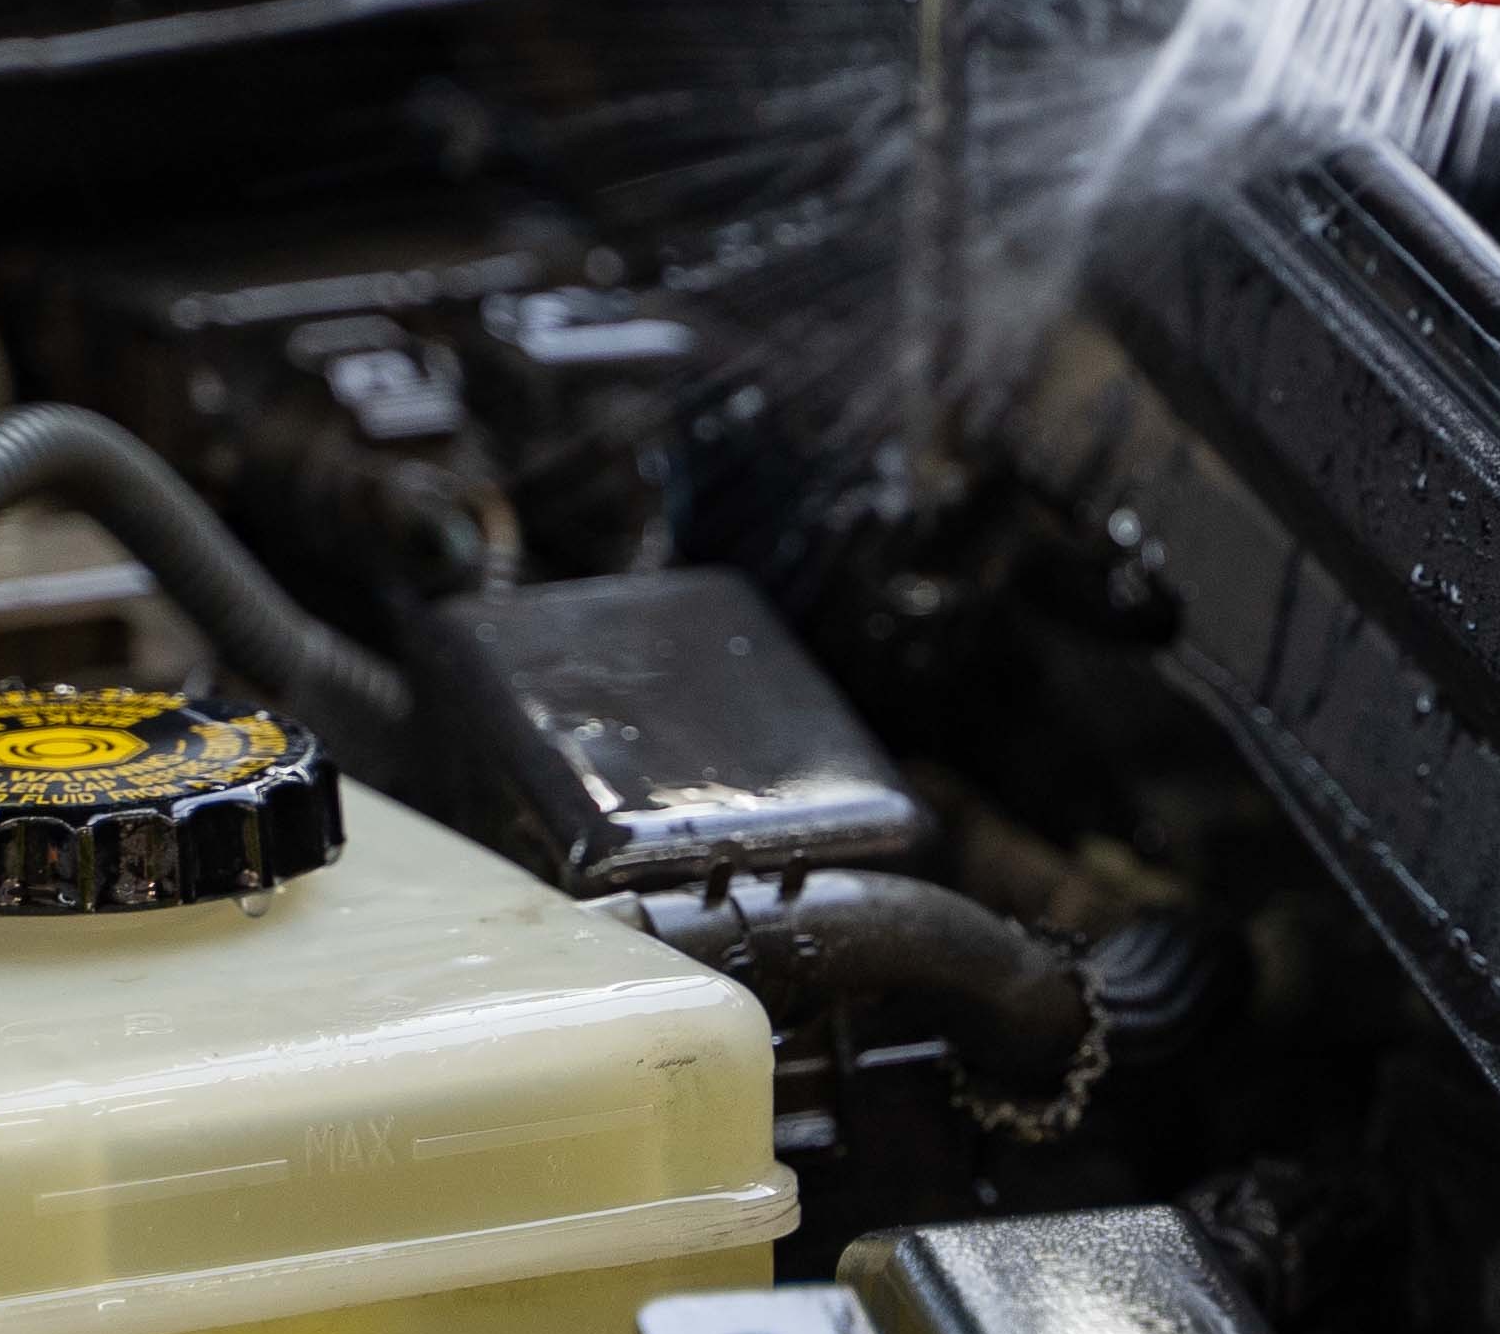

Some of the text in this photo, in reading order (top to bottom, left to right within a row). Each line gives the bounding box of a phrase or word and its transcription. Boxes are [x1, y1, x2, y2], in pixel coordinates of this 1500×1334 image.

[20, 792, 96, 805] FLUID
[108, 783, 184, 802] FROM
[63, 779, 117, 794] CAP
[304, 1114, 396, 1178] MAX
